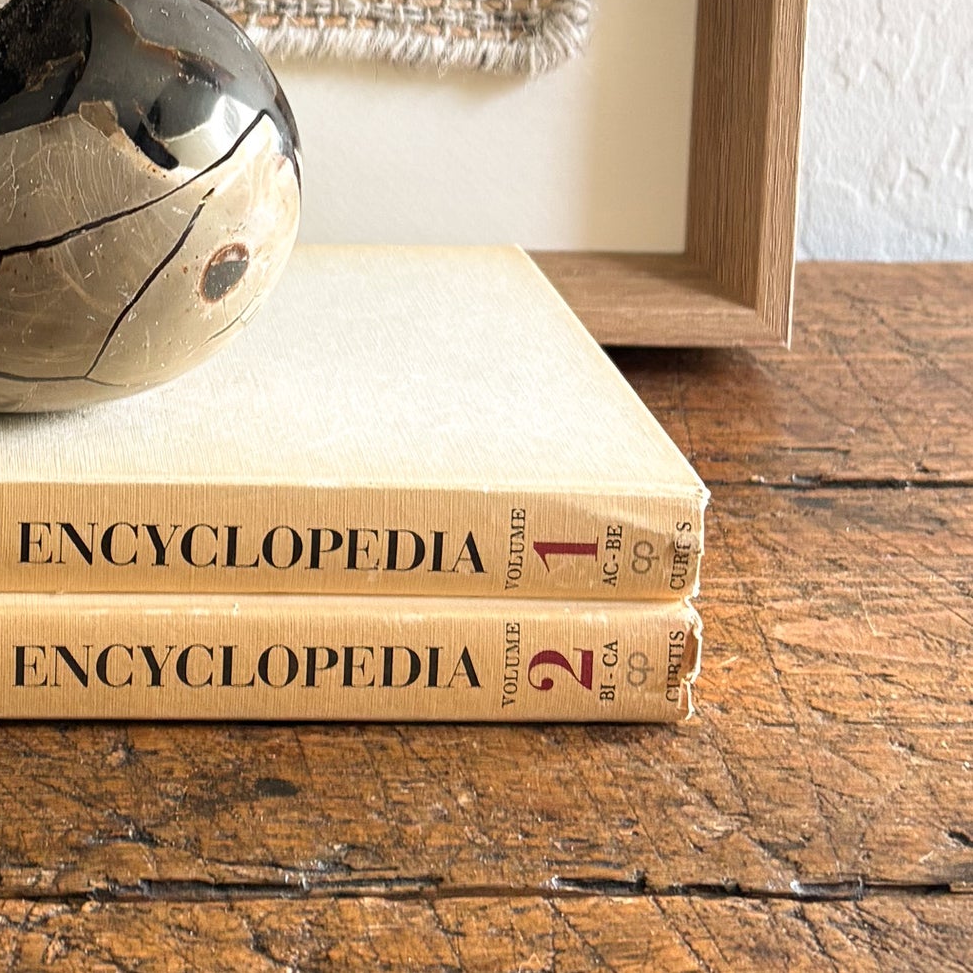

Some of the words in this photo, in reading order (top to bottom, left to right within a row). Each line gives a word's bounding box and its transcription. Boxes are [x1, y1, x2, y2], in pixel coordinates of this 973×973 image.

[17, 521, 488, 574] ENCYCLOPEDIA
[505, 508, 527, 590] VOLUME
[533, 536, 599, 574] 1
[670, 521, 693, 591] CURTS
[12, 643, 482, 689] ENCYCLOPEDIA
[502, 622, 521, 709] VOLUME
[528, 647, 594, 691] 2
